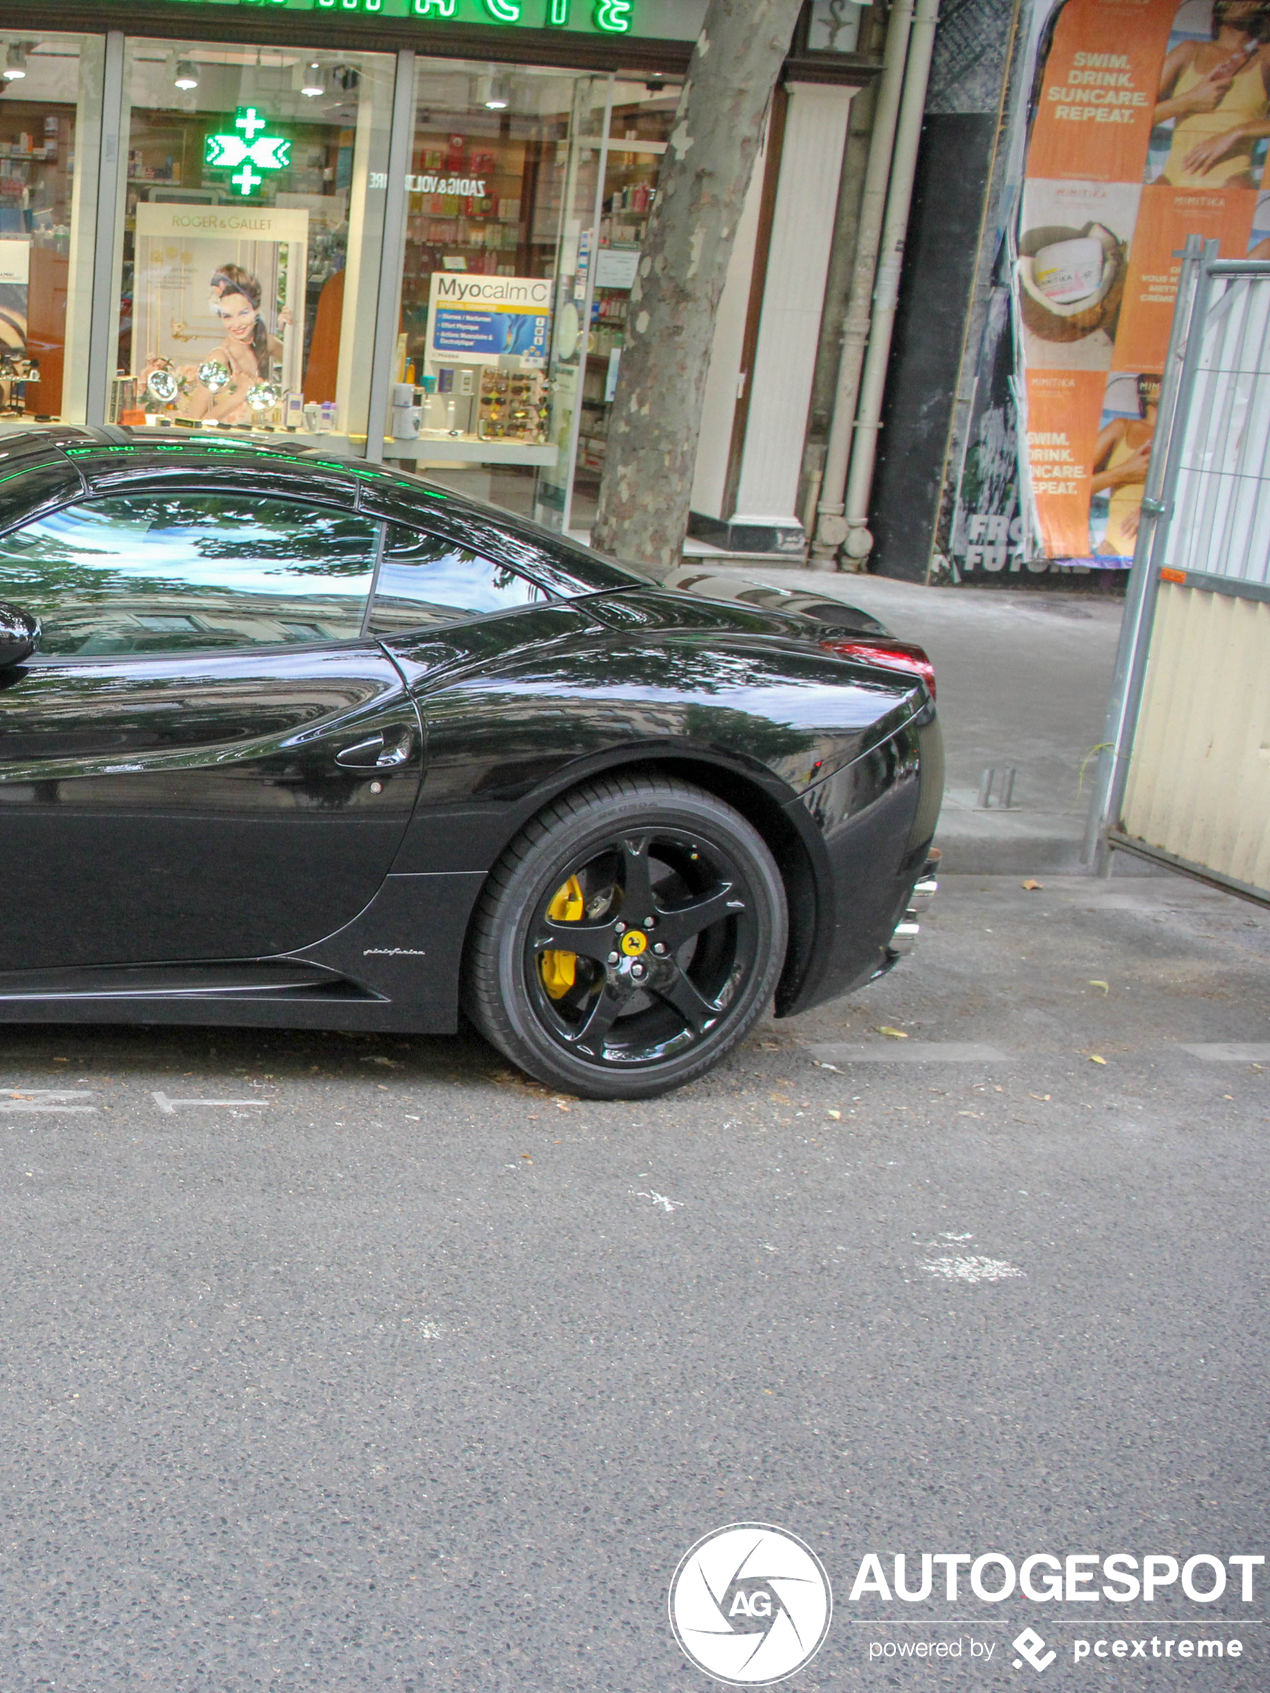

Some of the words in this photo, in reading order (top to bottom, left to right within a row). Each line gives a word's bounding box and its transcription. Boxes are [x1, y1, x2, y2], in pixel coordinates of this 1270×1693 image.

[1073, 51, 1131, 69] SWIM.
[1068, 69, 1135, 88] DRINK.
[1048, 86, 1149, 106] SUNCARE.
[1055, 105, 1135, 123] REPEAT.
[172, 215, 217, 228] ROGER
[219, 220, 226, 229] &
[228, 216, 273, 230] GALLET
[438, 278, 528, 300] Myocalm
[531, 284, 547, 301] C
[1139, 382, 1160, 390] MIM
[1031, 465, 1087, 479] NCARE.
[1032, 481, 1078, 495] EPEAT.
